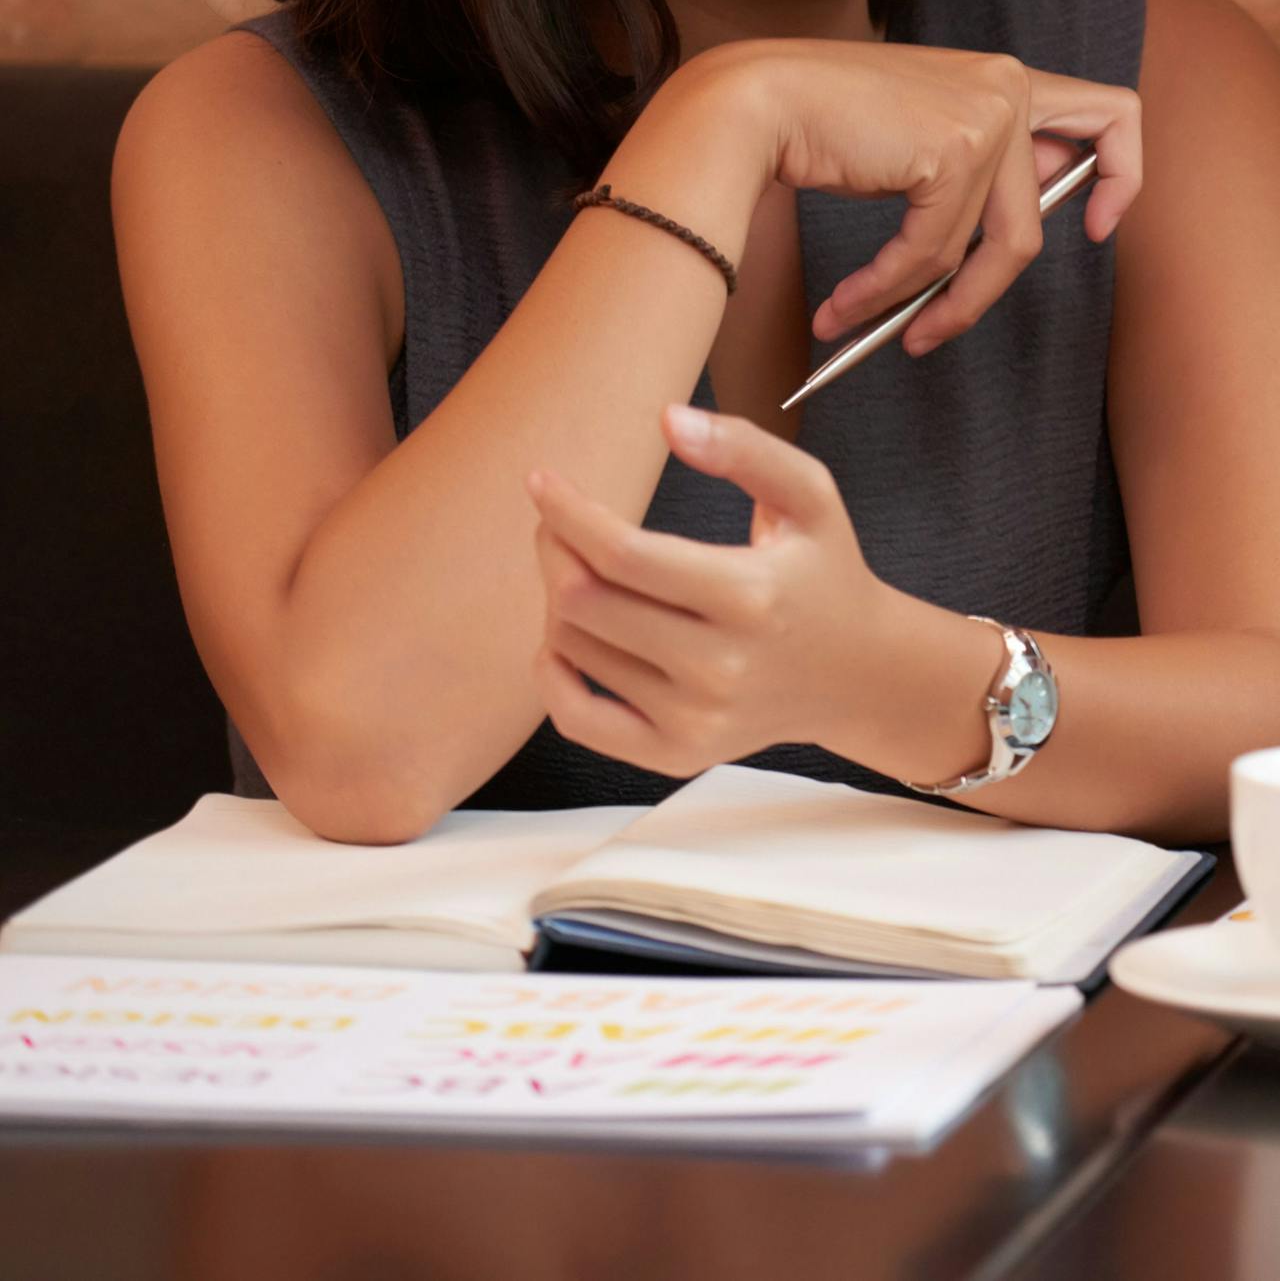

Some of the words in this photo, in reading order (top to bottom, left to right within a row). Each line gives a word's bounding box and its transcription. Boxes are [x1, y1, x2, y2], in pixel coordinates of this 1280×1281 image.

[64, 975, 406, 1002] DESIGN
[8, 1009, 356, 1030] DESIGN
[405, 1018, 682, 1040] ABC
[0, 1063, 272, 1084] DESIG
